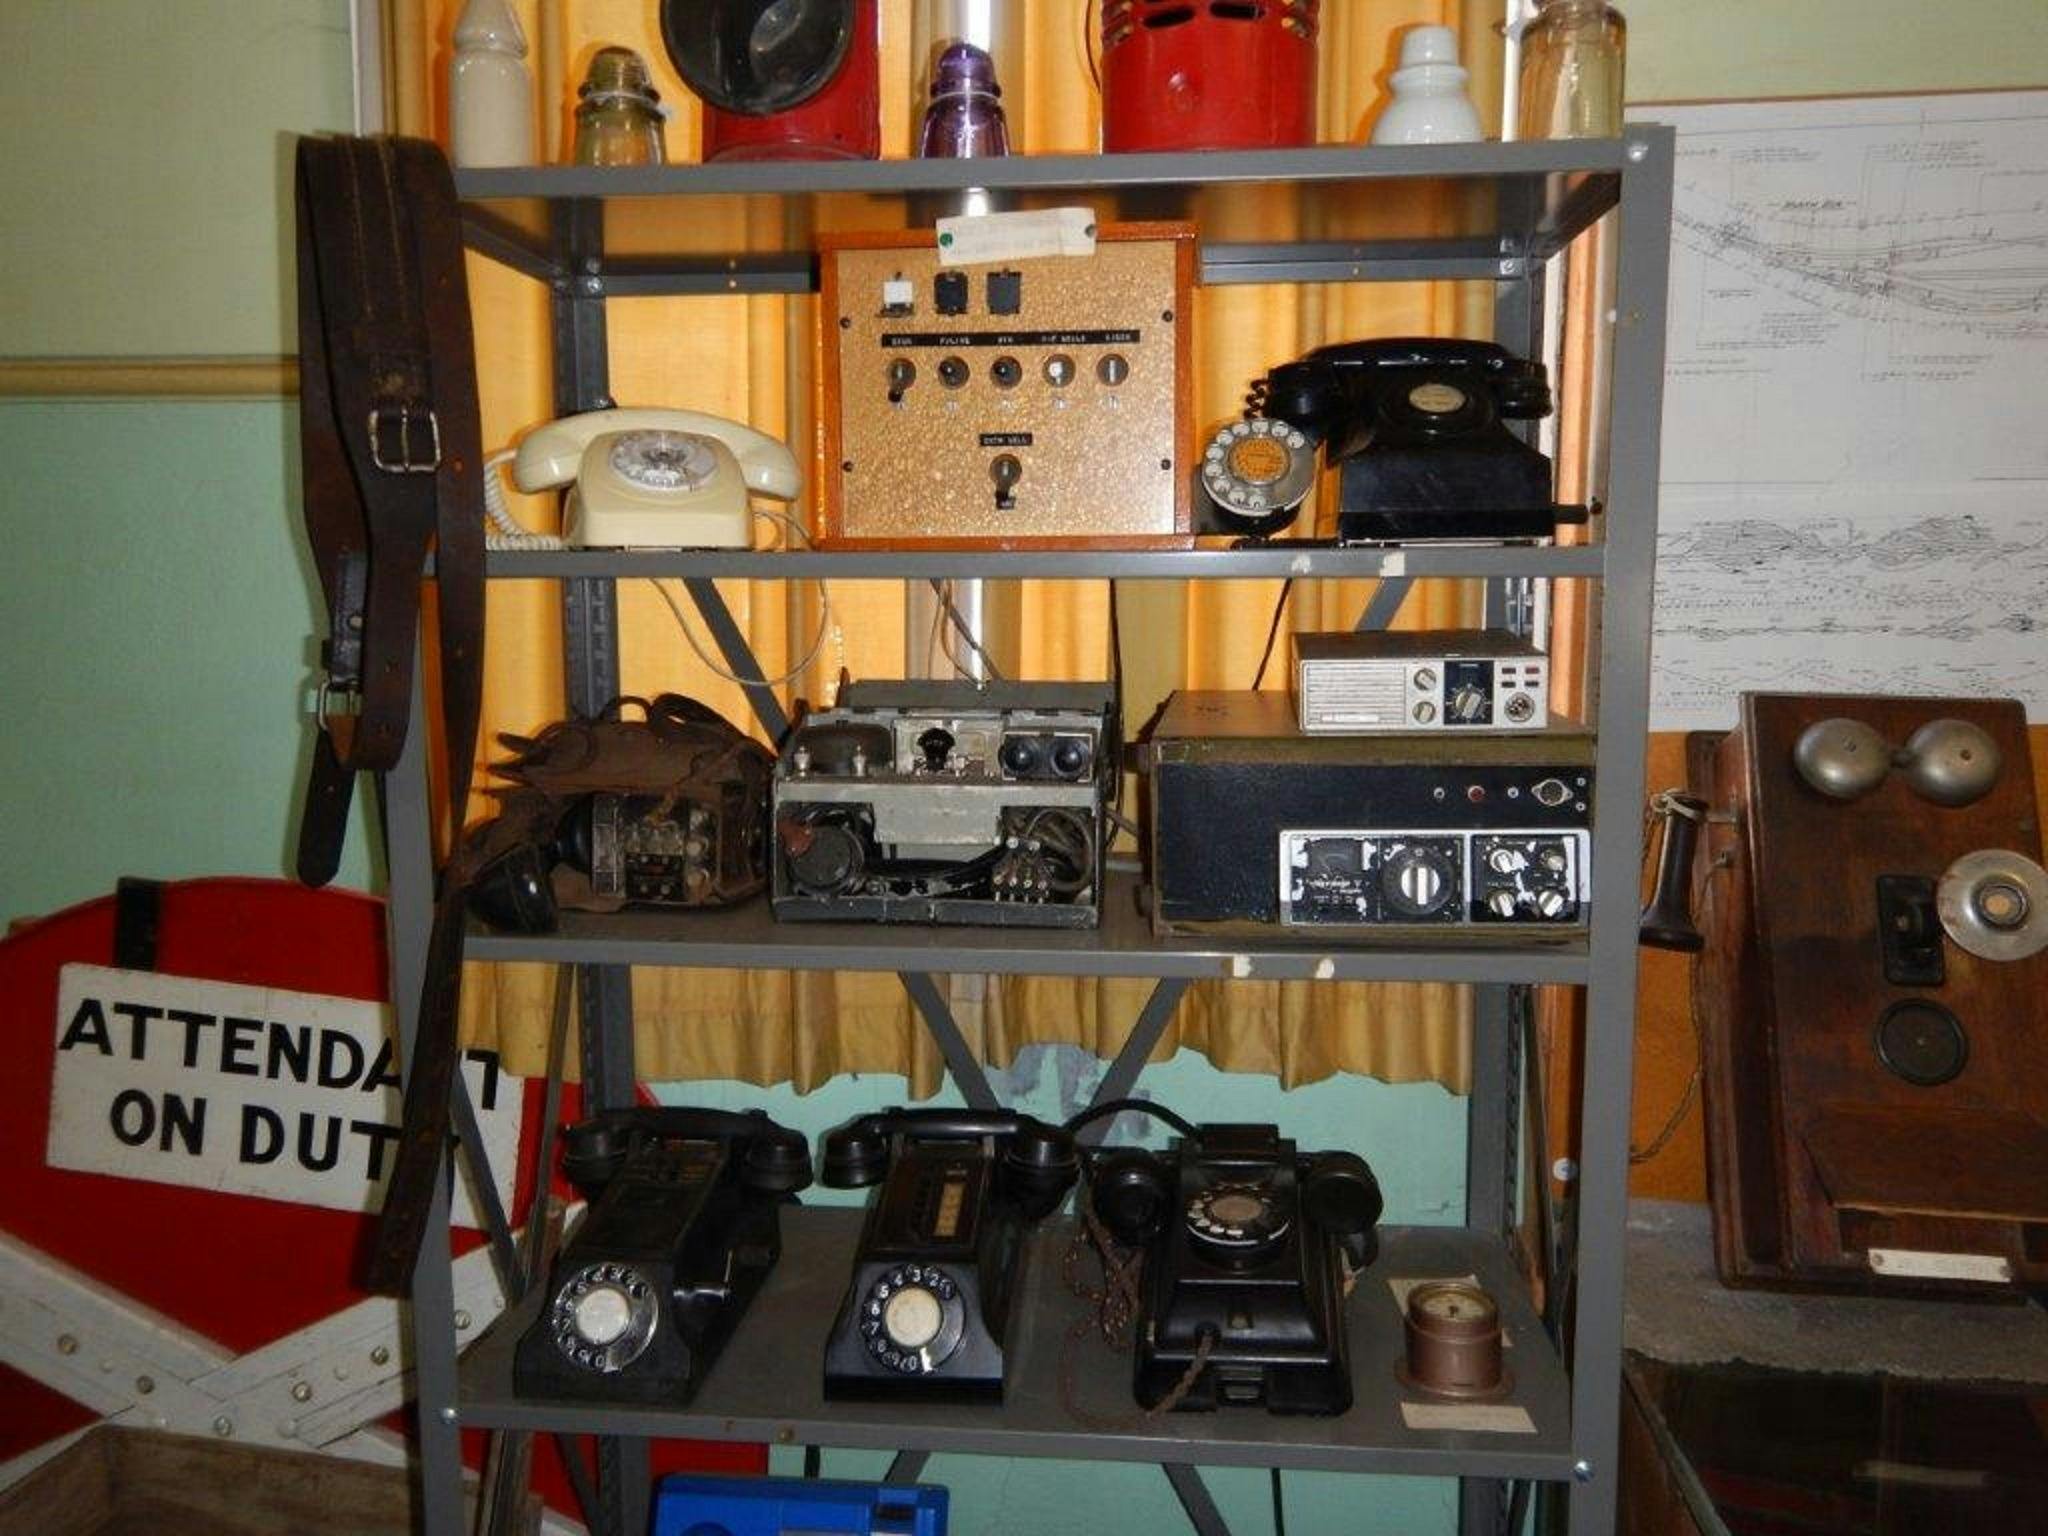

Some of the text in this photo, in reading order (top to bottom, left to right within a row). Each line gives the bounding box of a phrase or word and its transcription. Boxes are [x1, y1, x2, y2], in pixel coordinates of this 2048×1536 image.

[58, 999, 499, 1111] ATTENDAT
[109, 1089, 460, 1181] ON DUT
[912, 1268, 921, 1282] 3
[929, 1273, 940, 1287] 2
[880, 1284, 889, 1299] 5
[871, 1303, 880, 1316] 6
[871, 1322, 880, 1335] 7
[908, 1355, 917, 1370] 0
